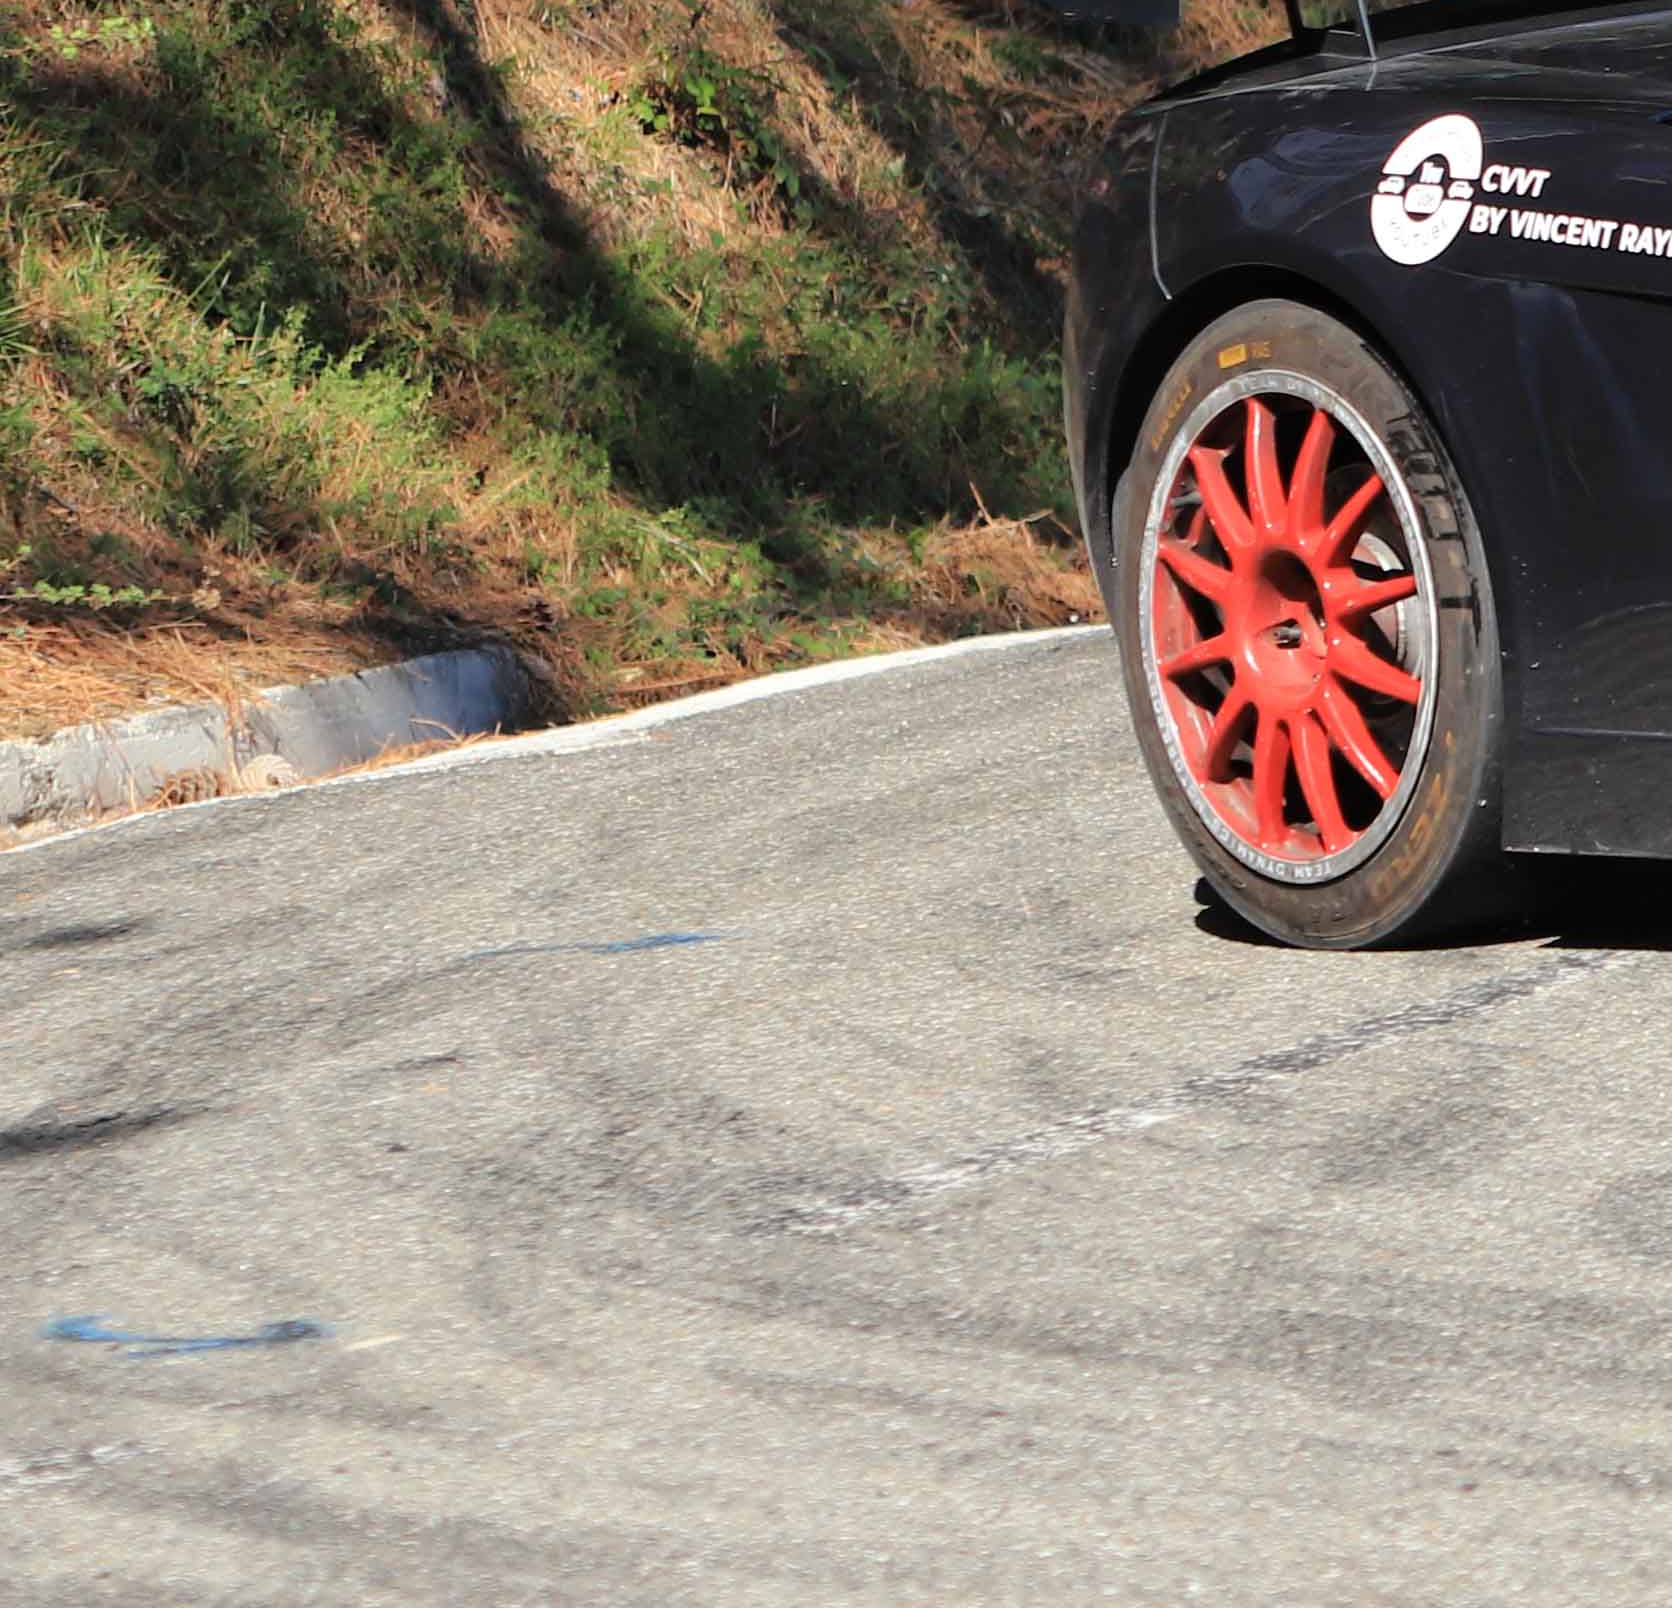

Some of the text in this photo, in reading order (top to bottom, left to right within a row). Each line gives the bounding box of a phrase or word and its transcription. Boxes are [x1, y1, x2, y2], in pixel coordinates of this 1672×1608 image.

[1480, 163, 1552, 199] CVVT
[1470, 205, 1508, 235] BY
[1510, 208, 1619, 250] VINCENT
